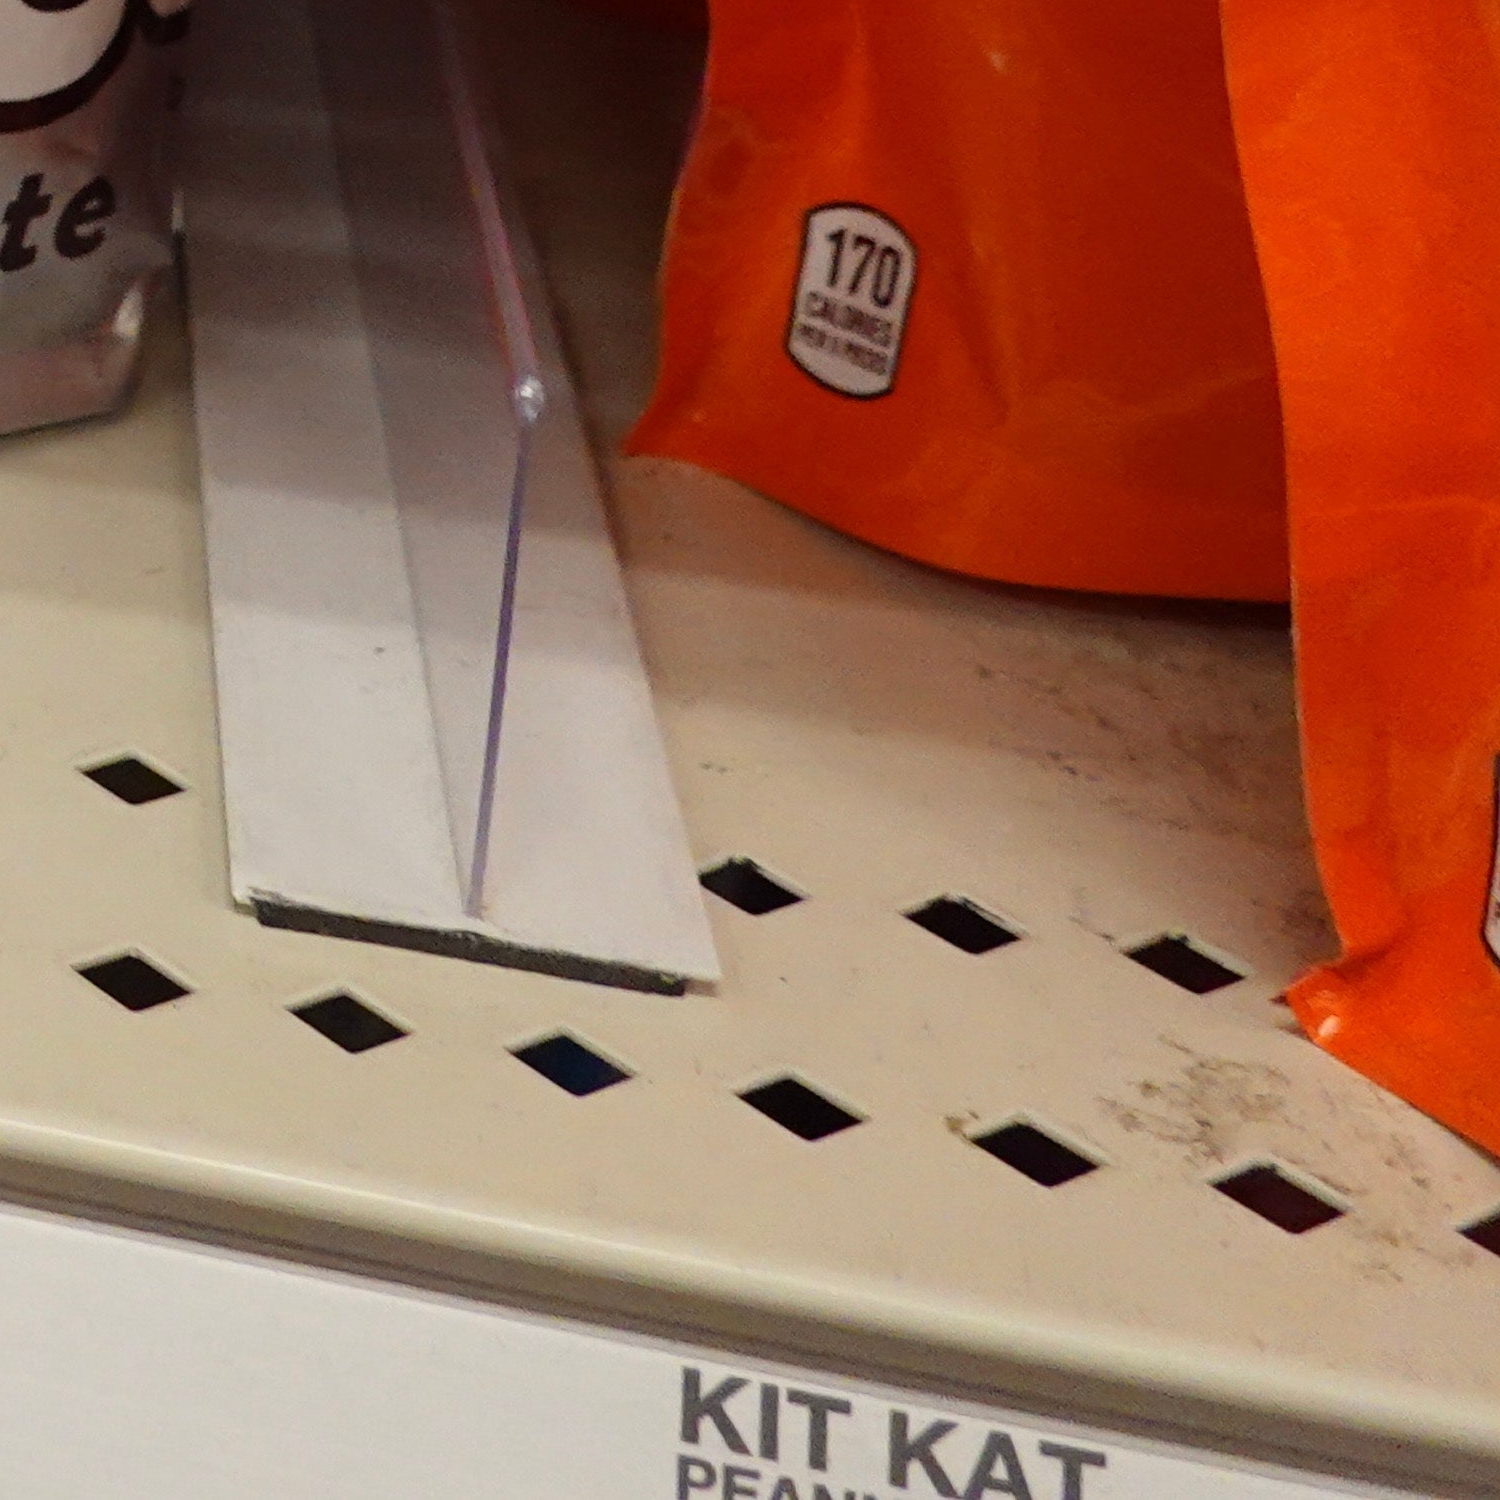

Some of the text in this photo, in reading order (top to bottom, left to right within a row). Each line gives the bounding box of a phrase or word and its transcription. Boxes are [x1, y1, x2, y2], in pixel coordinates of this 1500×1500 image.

[825, 227, 901, 308] 170
[679, 1366, 1108, 1500] KIT KAT
